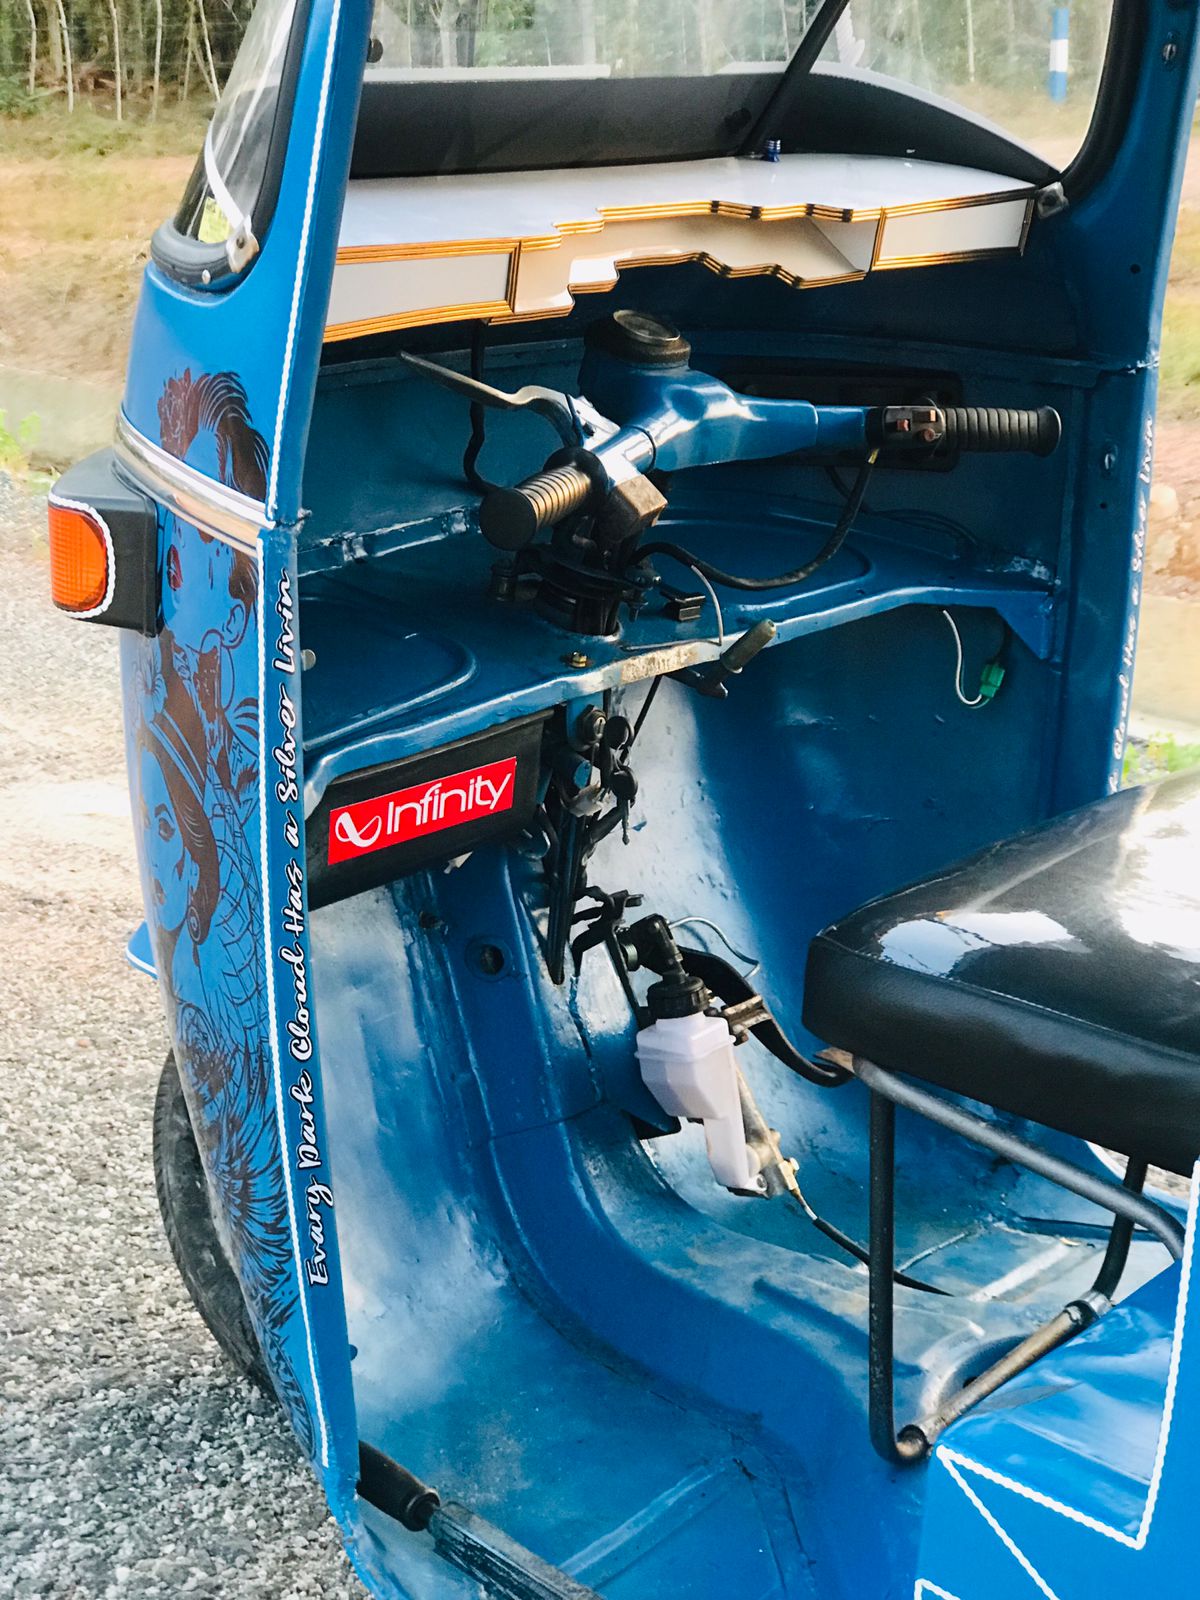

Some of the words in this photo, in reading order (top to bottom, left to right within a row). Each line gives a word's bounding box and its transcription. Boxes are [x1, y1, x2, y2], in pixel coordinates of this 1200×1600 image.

[272, 682, 298, 803] Silver
[282, 809, 299, 848] a
[386, 773, 512, 835] Infinity
[281, 858, 304, 937] Has
[279, 941, 313, 1062] Cloud
[290, 1069, 322, 1169] Dark
